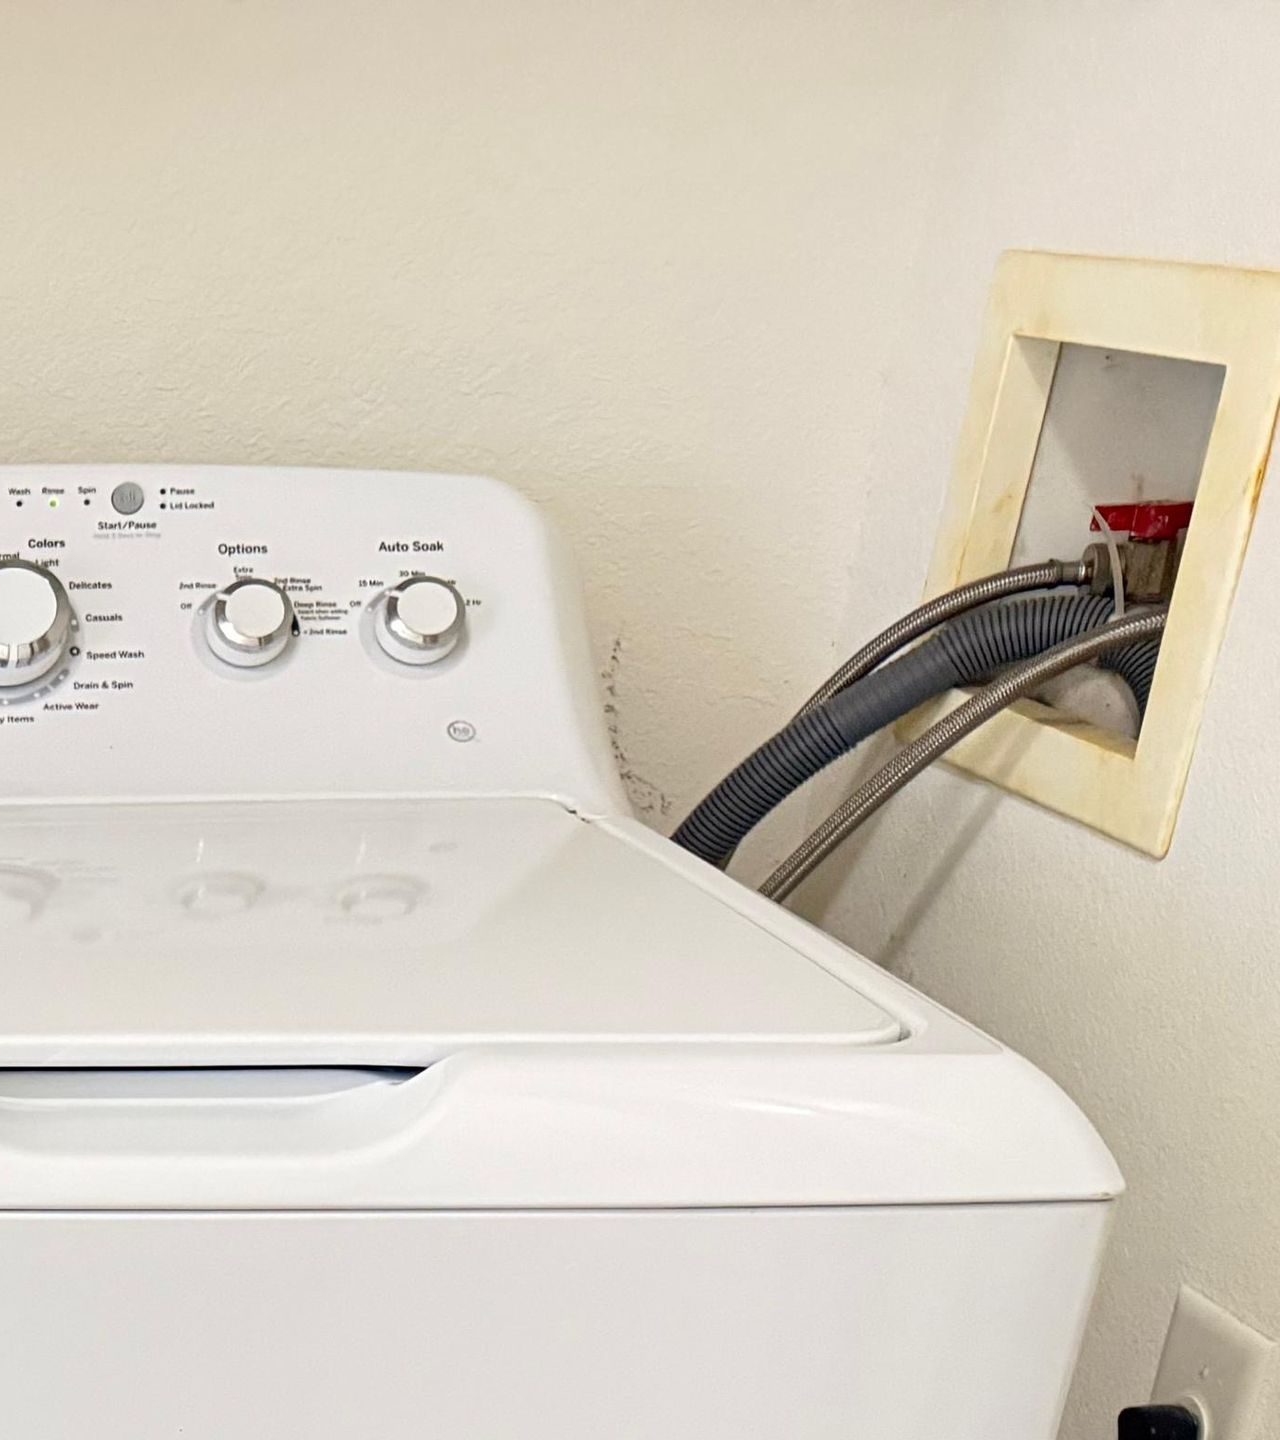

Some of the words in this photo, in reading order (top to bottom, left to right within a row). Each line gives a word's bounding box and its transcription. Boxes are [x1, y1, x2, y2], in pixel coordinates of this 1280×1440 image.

[78, 486, 96, 496] Spin
[185, 501, 214, 509] Locked
[98, 521, 157, 530] Start/Pause
[28, 539, 65, 548] Colors
[378, 541, 409, 552] Auto
[412, 541, 444, 552] Soak
[218, 543, 268, 557] Options
[35, 559, 59, 568] Lght
[69, 581, 112, 589] Delicates
[85, 613, 123, 622] Casuals
[87, 651, 115, 661] Speed
[118, 650, 144, 659] Wash
[74, 681, 99, 689] Drain
[112, 681, 133, 690] Spin
[43, 703, 69, 711] Active
[70, 703, 98, 711] Wear
[7, 715, 34, 723] Items
